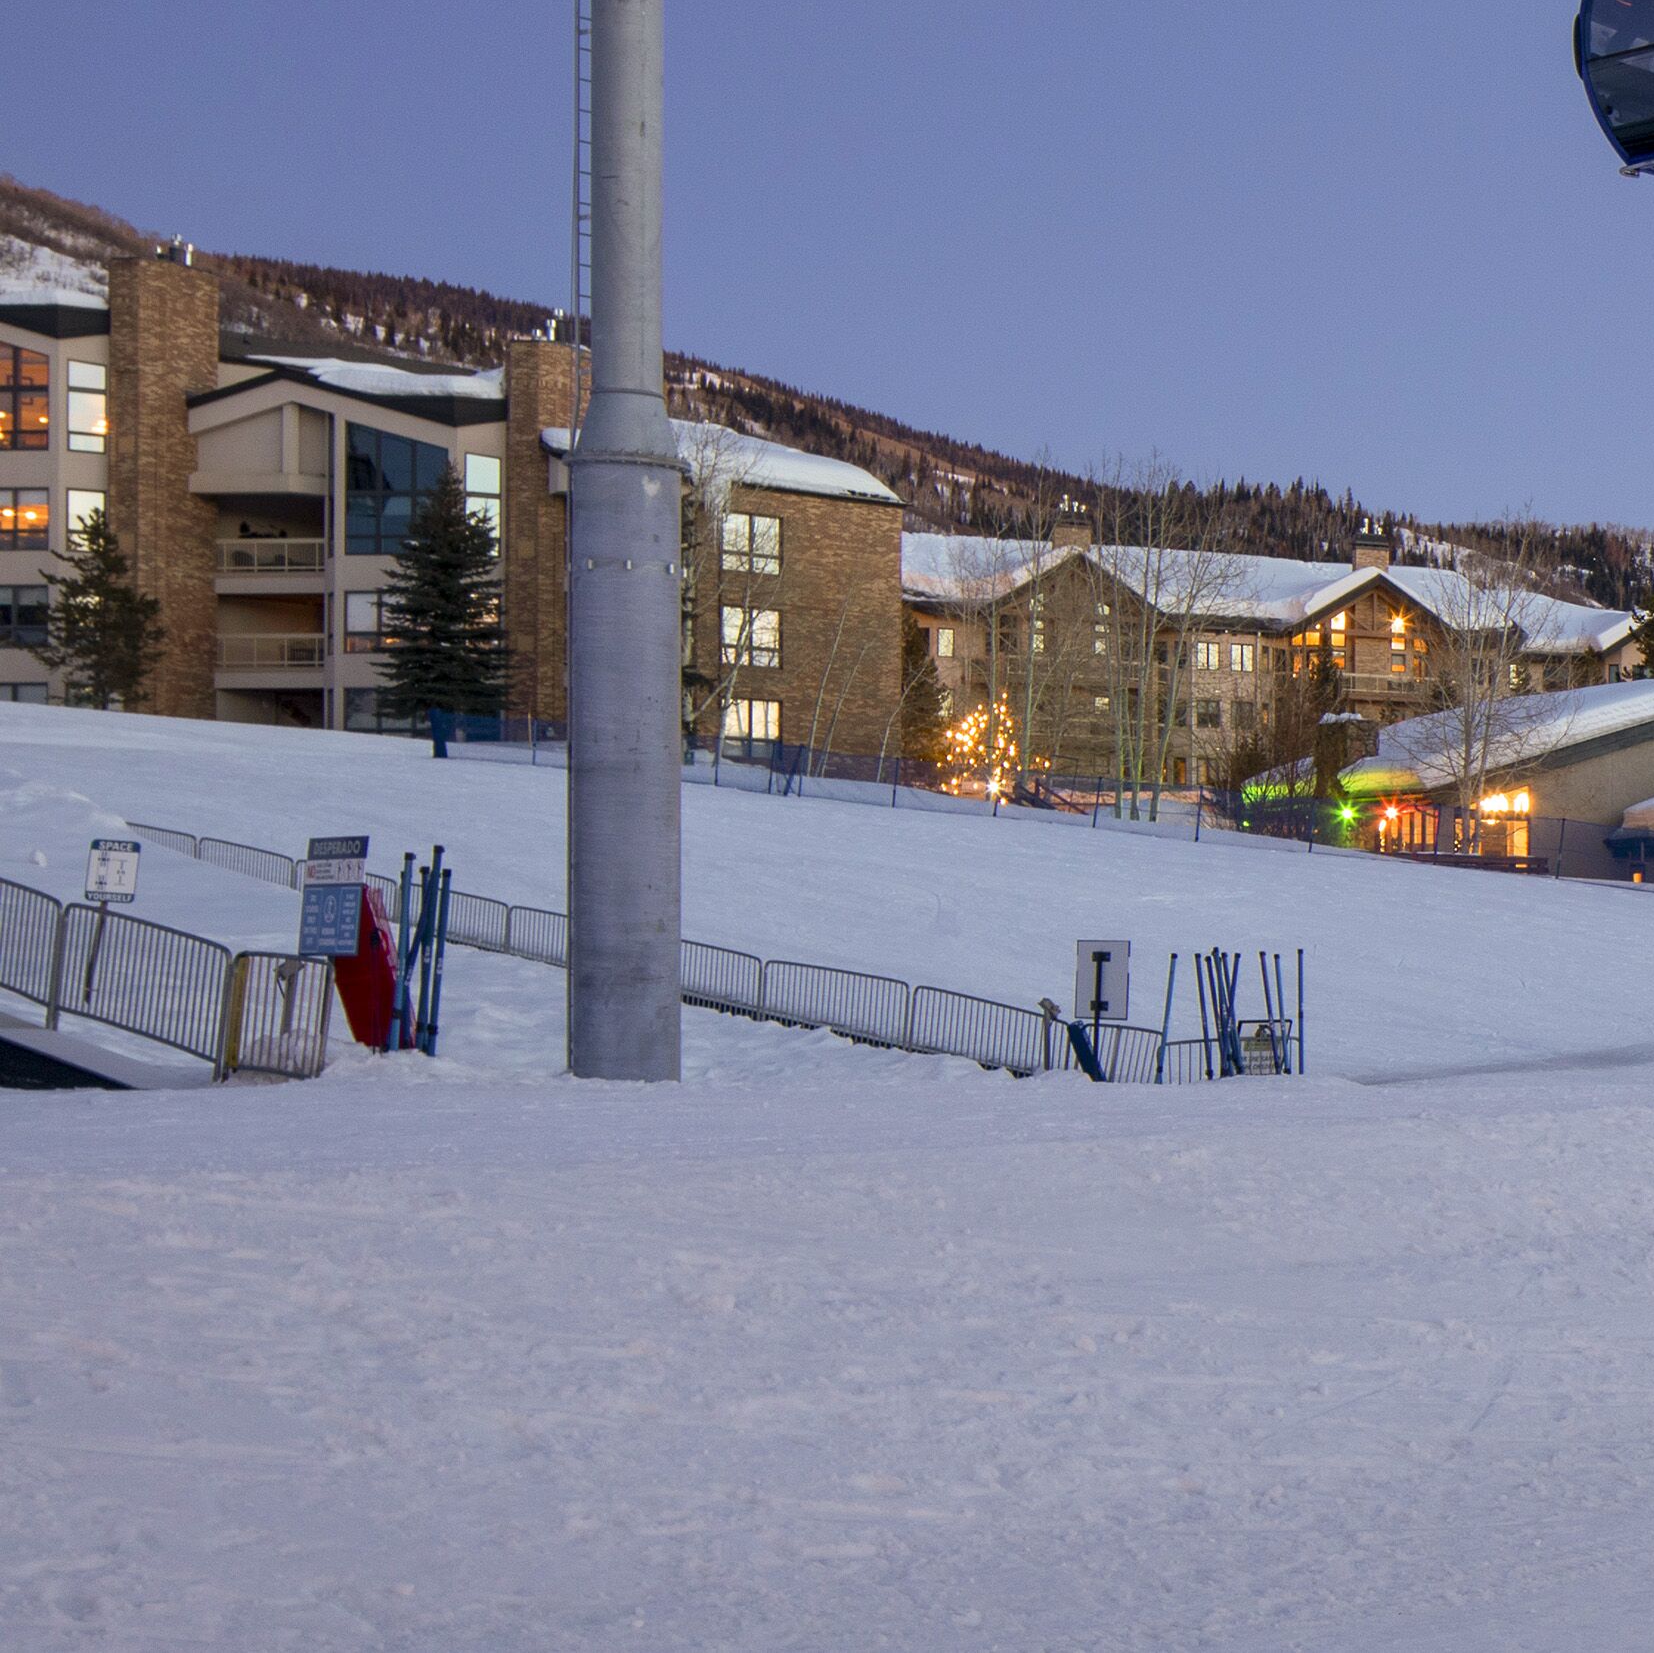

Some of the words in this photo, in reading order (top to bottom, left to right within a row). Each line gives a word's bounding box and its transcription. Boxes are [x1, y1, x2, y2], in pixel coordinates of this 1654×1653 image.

[98, 841, 134, 853] SPACE
[312, 840, 361, 856] DESPERADO
[86, 892, 132, 903] YOURSELF
